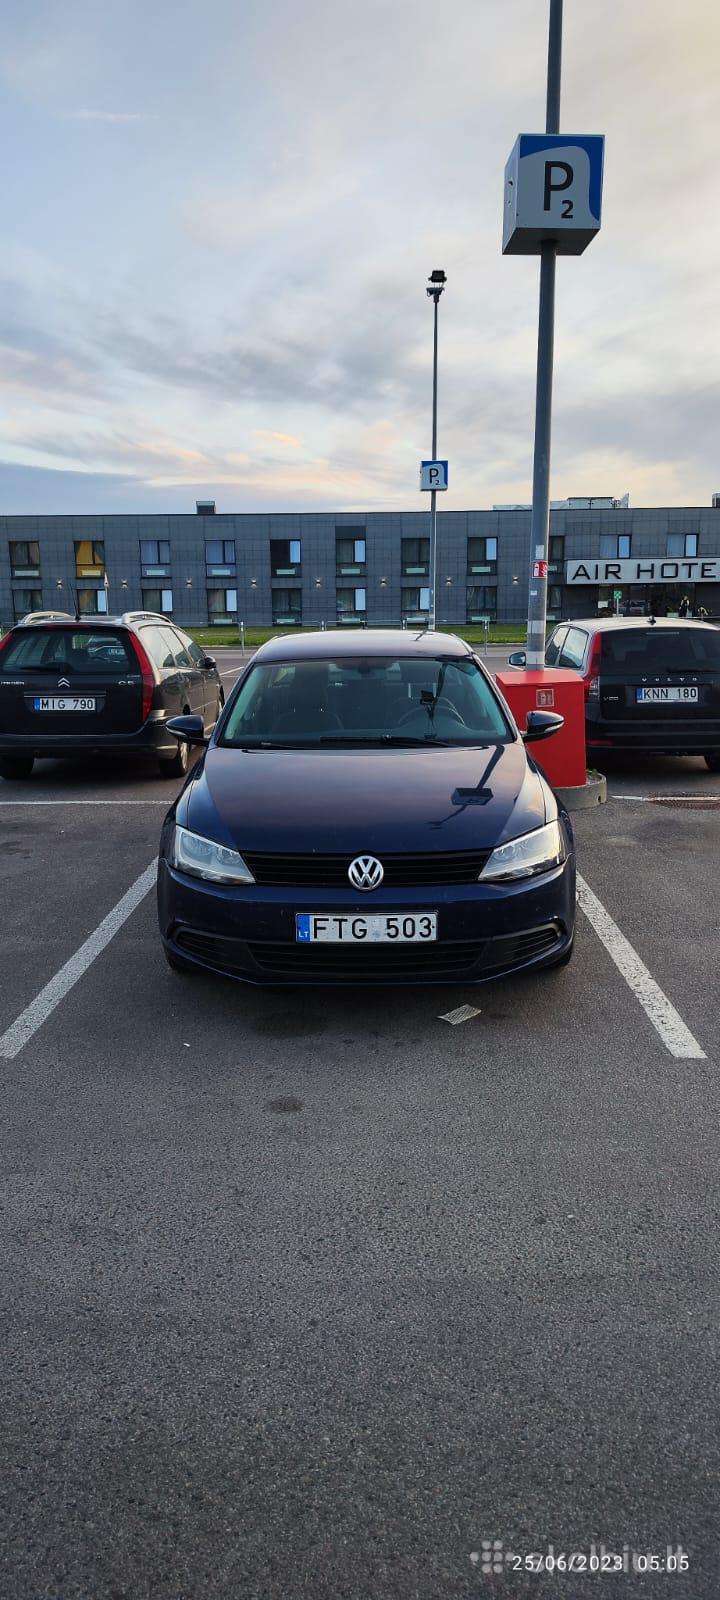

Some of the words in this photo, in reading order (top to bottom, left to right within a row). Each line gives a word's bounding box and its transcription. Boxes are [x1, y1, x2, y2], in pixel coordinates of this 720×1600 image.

[572, 564, 621, 579] AIR
[637, 562, 717, 579] HOTE
[643, 688, 668, 699] KNN
[678, 688, 697, 698] 180
[41, 699, 66, 710] MIG
[72, 699, 94, 710] 790
[313, 917, 368, 939] FTG
[386, 916, 432, 939] 503
